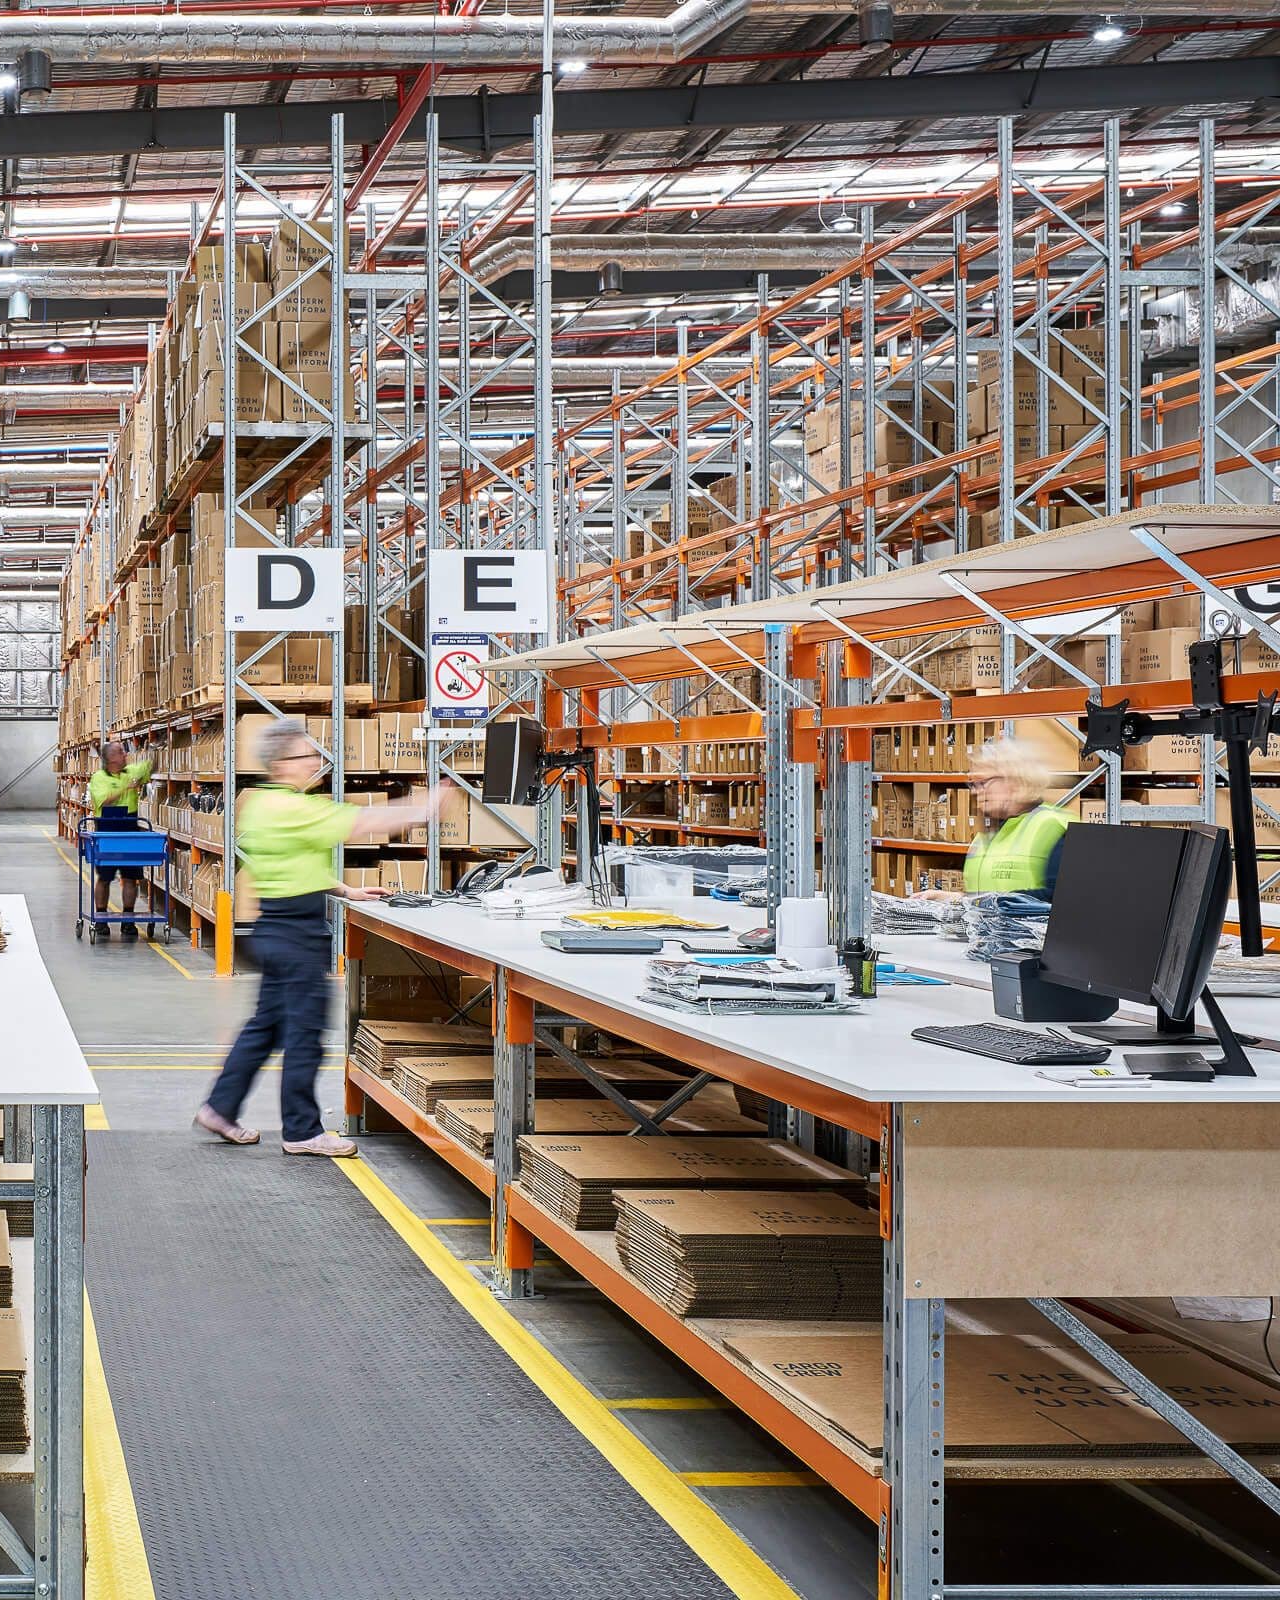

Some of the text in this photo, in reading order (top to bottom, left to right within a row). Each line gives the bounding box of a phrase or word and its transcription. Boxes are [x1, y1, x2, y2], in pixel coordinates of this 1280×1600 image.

[258, 555, 315, 609] D
[464, 557, 516, 611] E
[773, 1362, 843, 1370] CARGO
[988, 1373, 1082, 1383] THE
[1015, 1386, 1240, 1396] MODRN
